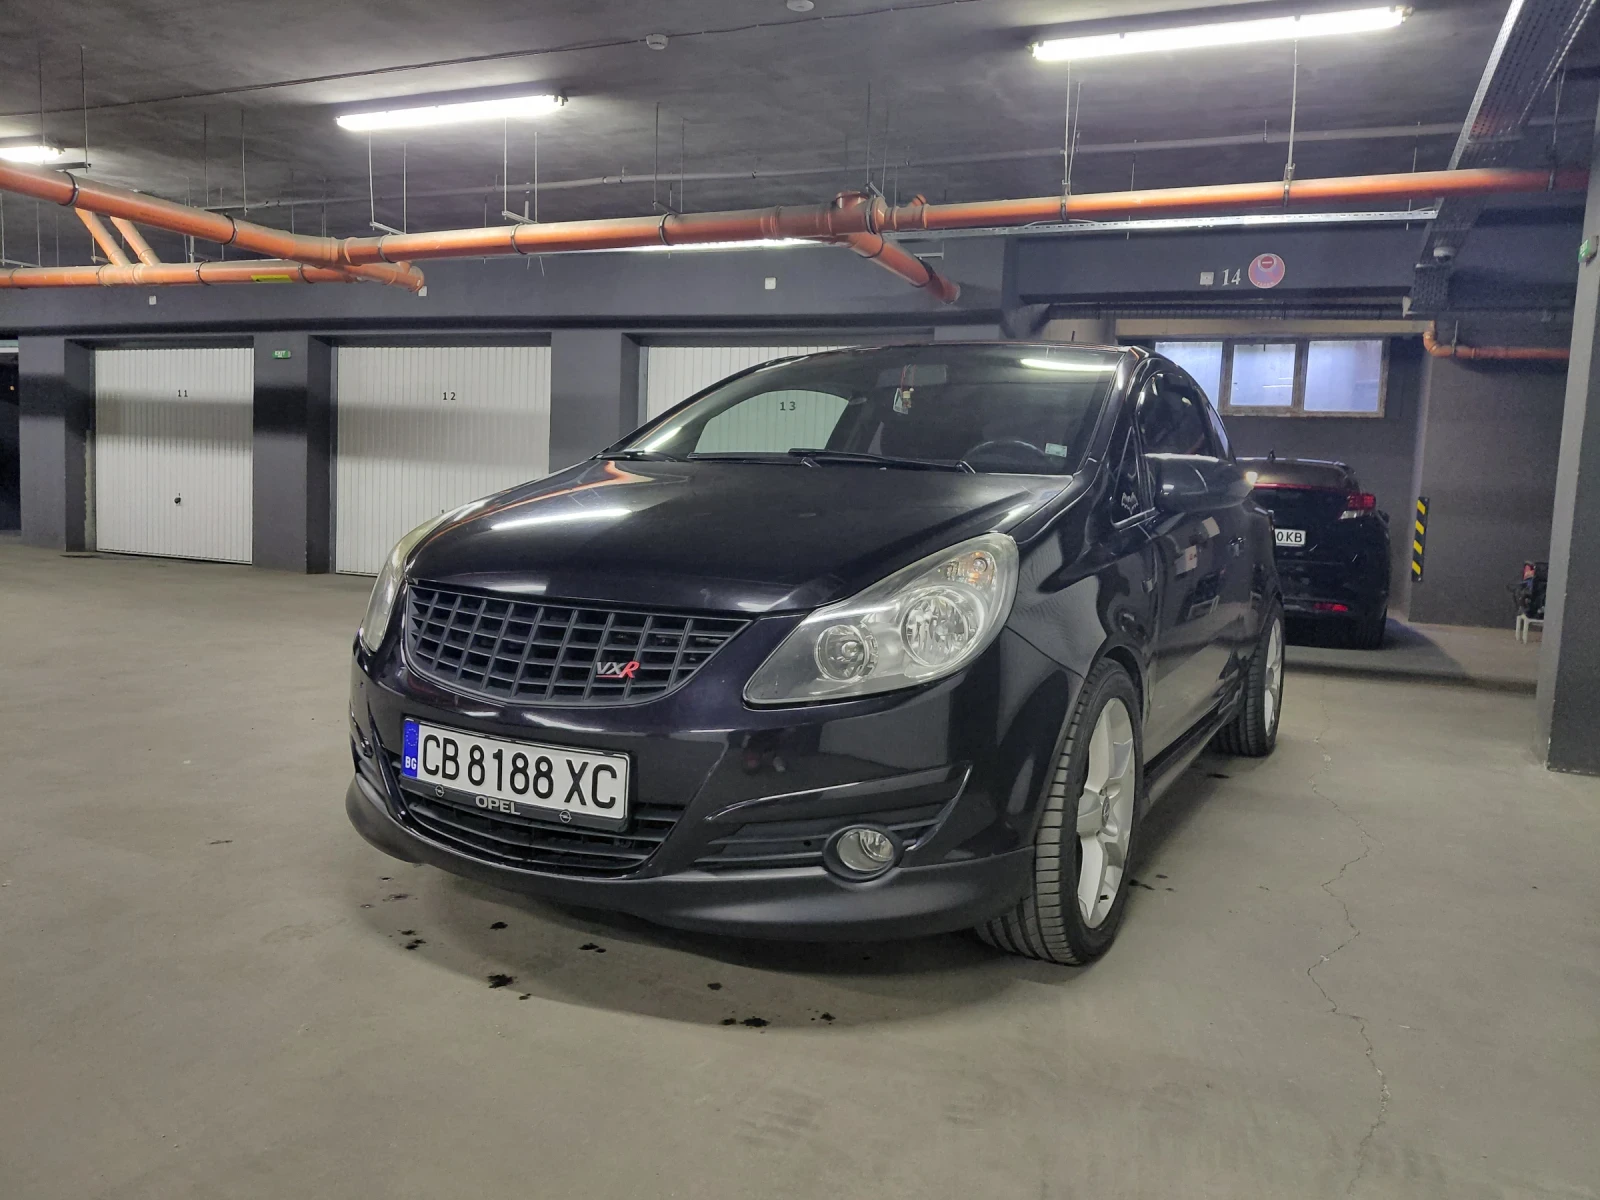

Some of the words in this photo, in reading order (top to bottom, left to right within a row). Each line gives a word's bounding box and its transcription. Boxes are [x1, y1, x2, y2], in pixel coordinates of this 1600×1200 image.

[1222, 268, 1241, 286] 14
[178, 389, 188, 397] 11
[443, 391, 456, 401] 12
[779, 401, 796, 411] 13
[596, 661, 640, 678] VXR
[404, 755, 417, 770] BG
[467, 744, 554, 799] 8188
[475, 795, 521, 815] OPEL
